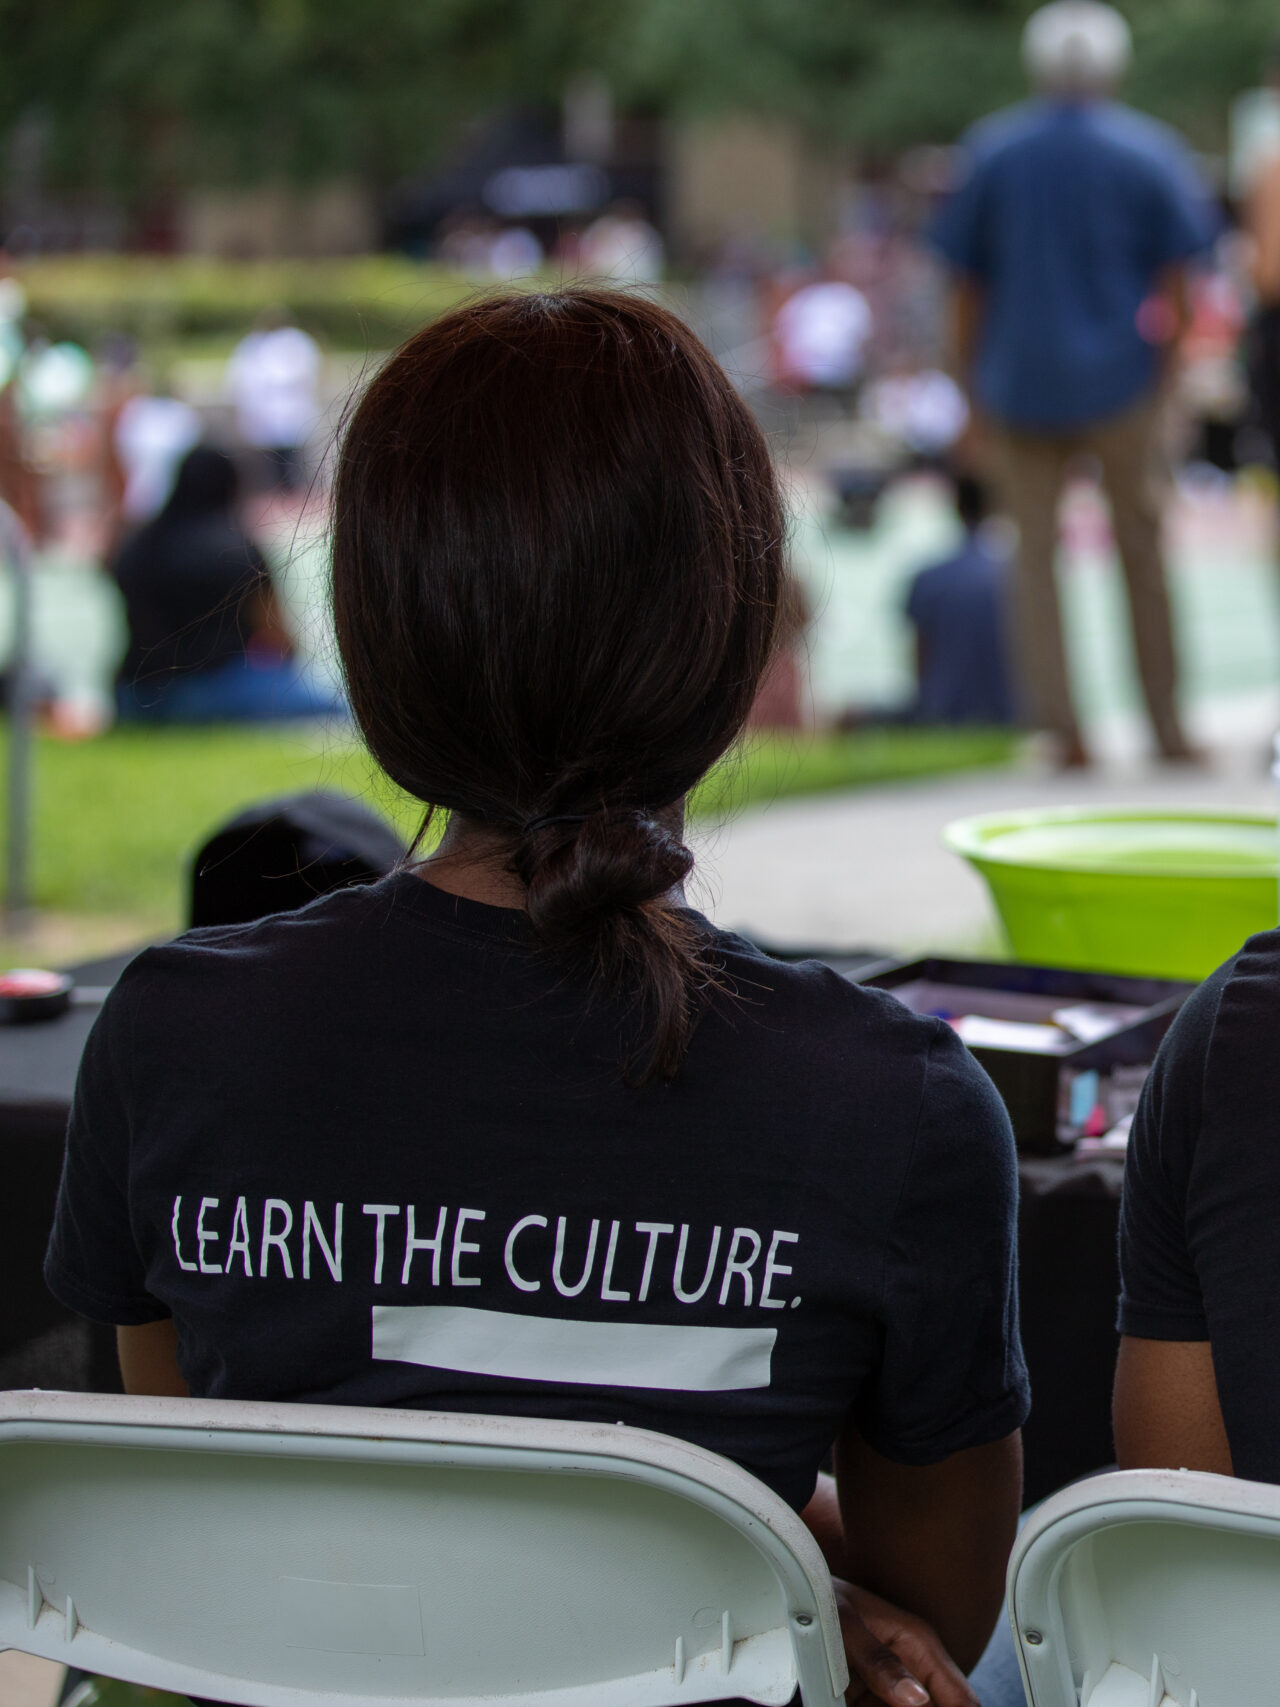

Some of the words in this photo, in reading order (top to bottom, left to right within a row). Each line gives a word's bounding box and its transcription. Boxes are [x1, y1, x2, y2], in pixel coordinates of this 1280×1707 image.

[171, 1195, 344, 1282] LEARN
[362, 1204, 486, 1286] THE
[504, 1214, 802, 1309] CULTURE.
